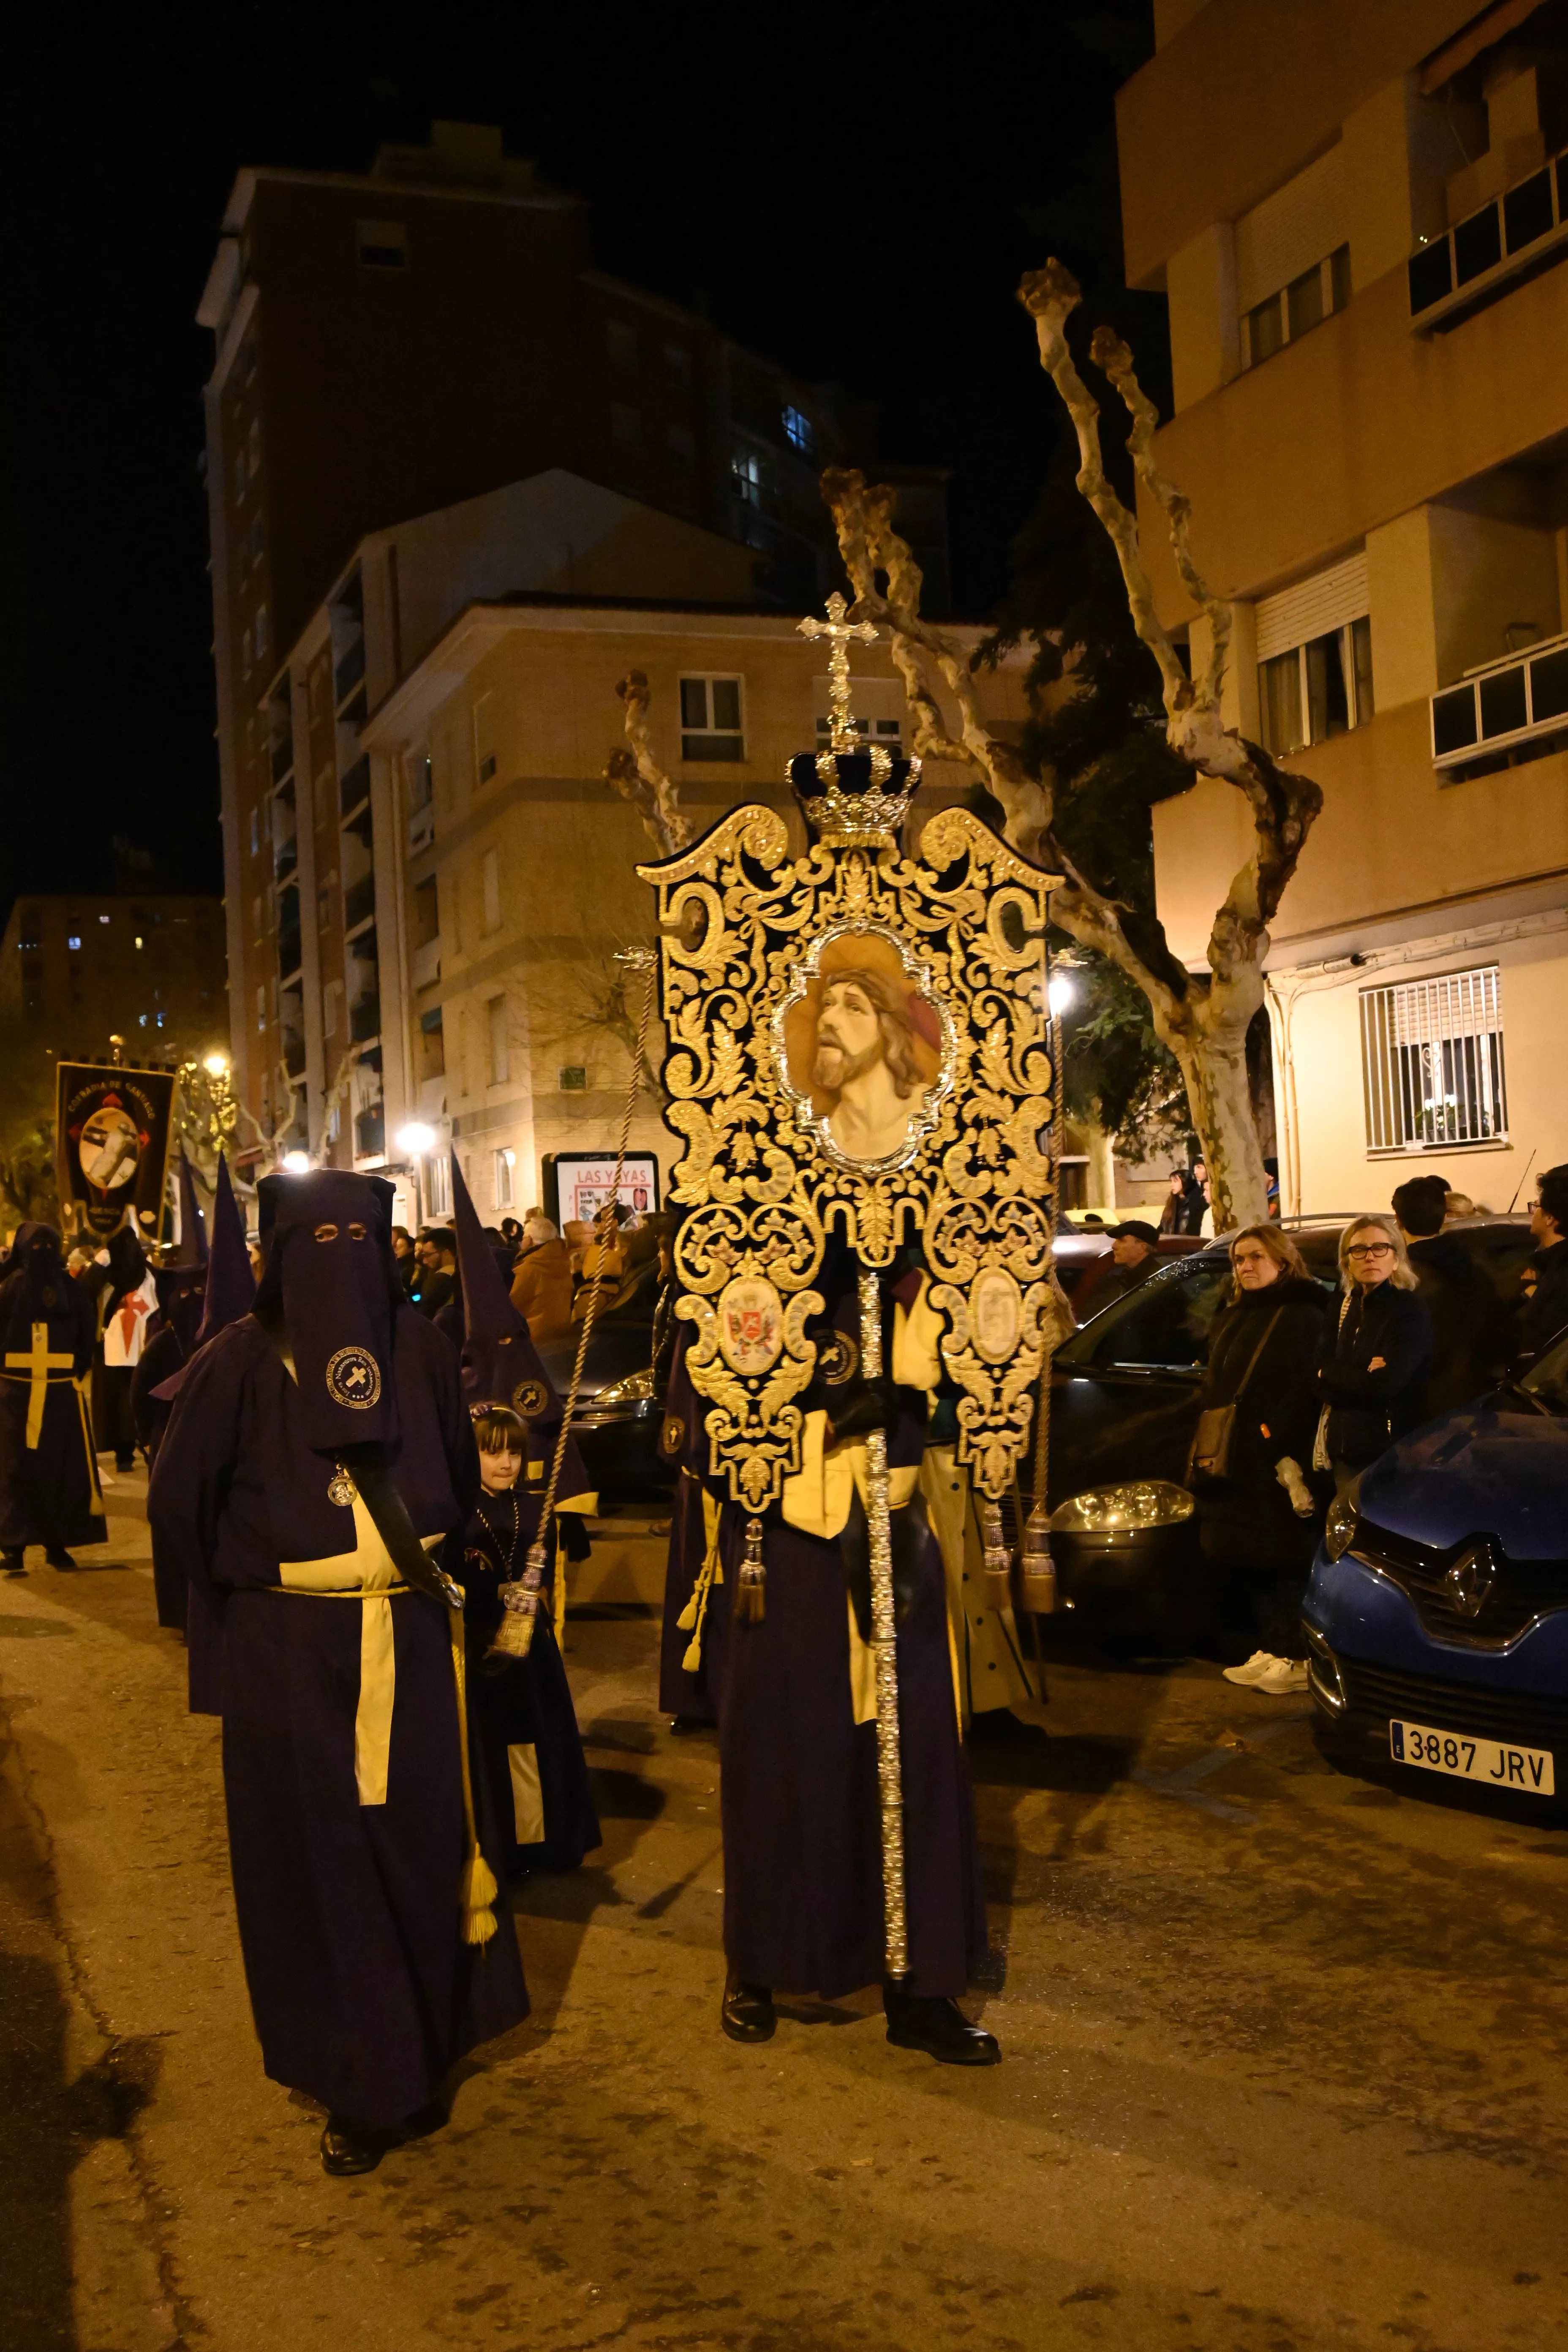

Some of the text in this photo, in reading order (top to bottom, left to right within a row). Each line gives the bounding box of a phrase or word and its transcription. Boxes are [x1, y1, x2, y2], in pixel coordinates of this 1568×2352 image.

[110, 1081, 122, 1089] DE
[577, 1170, 647, 1183] LAS YYAS
[1396, 1731, 1544, 1787] E 3887 JRV
